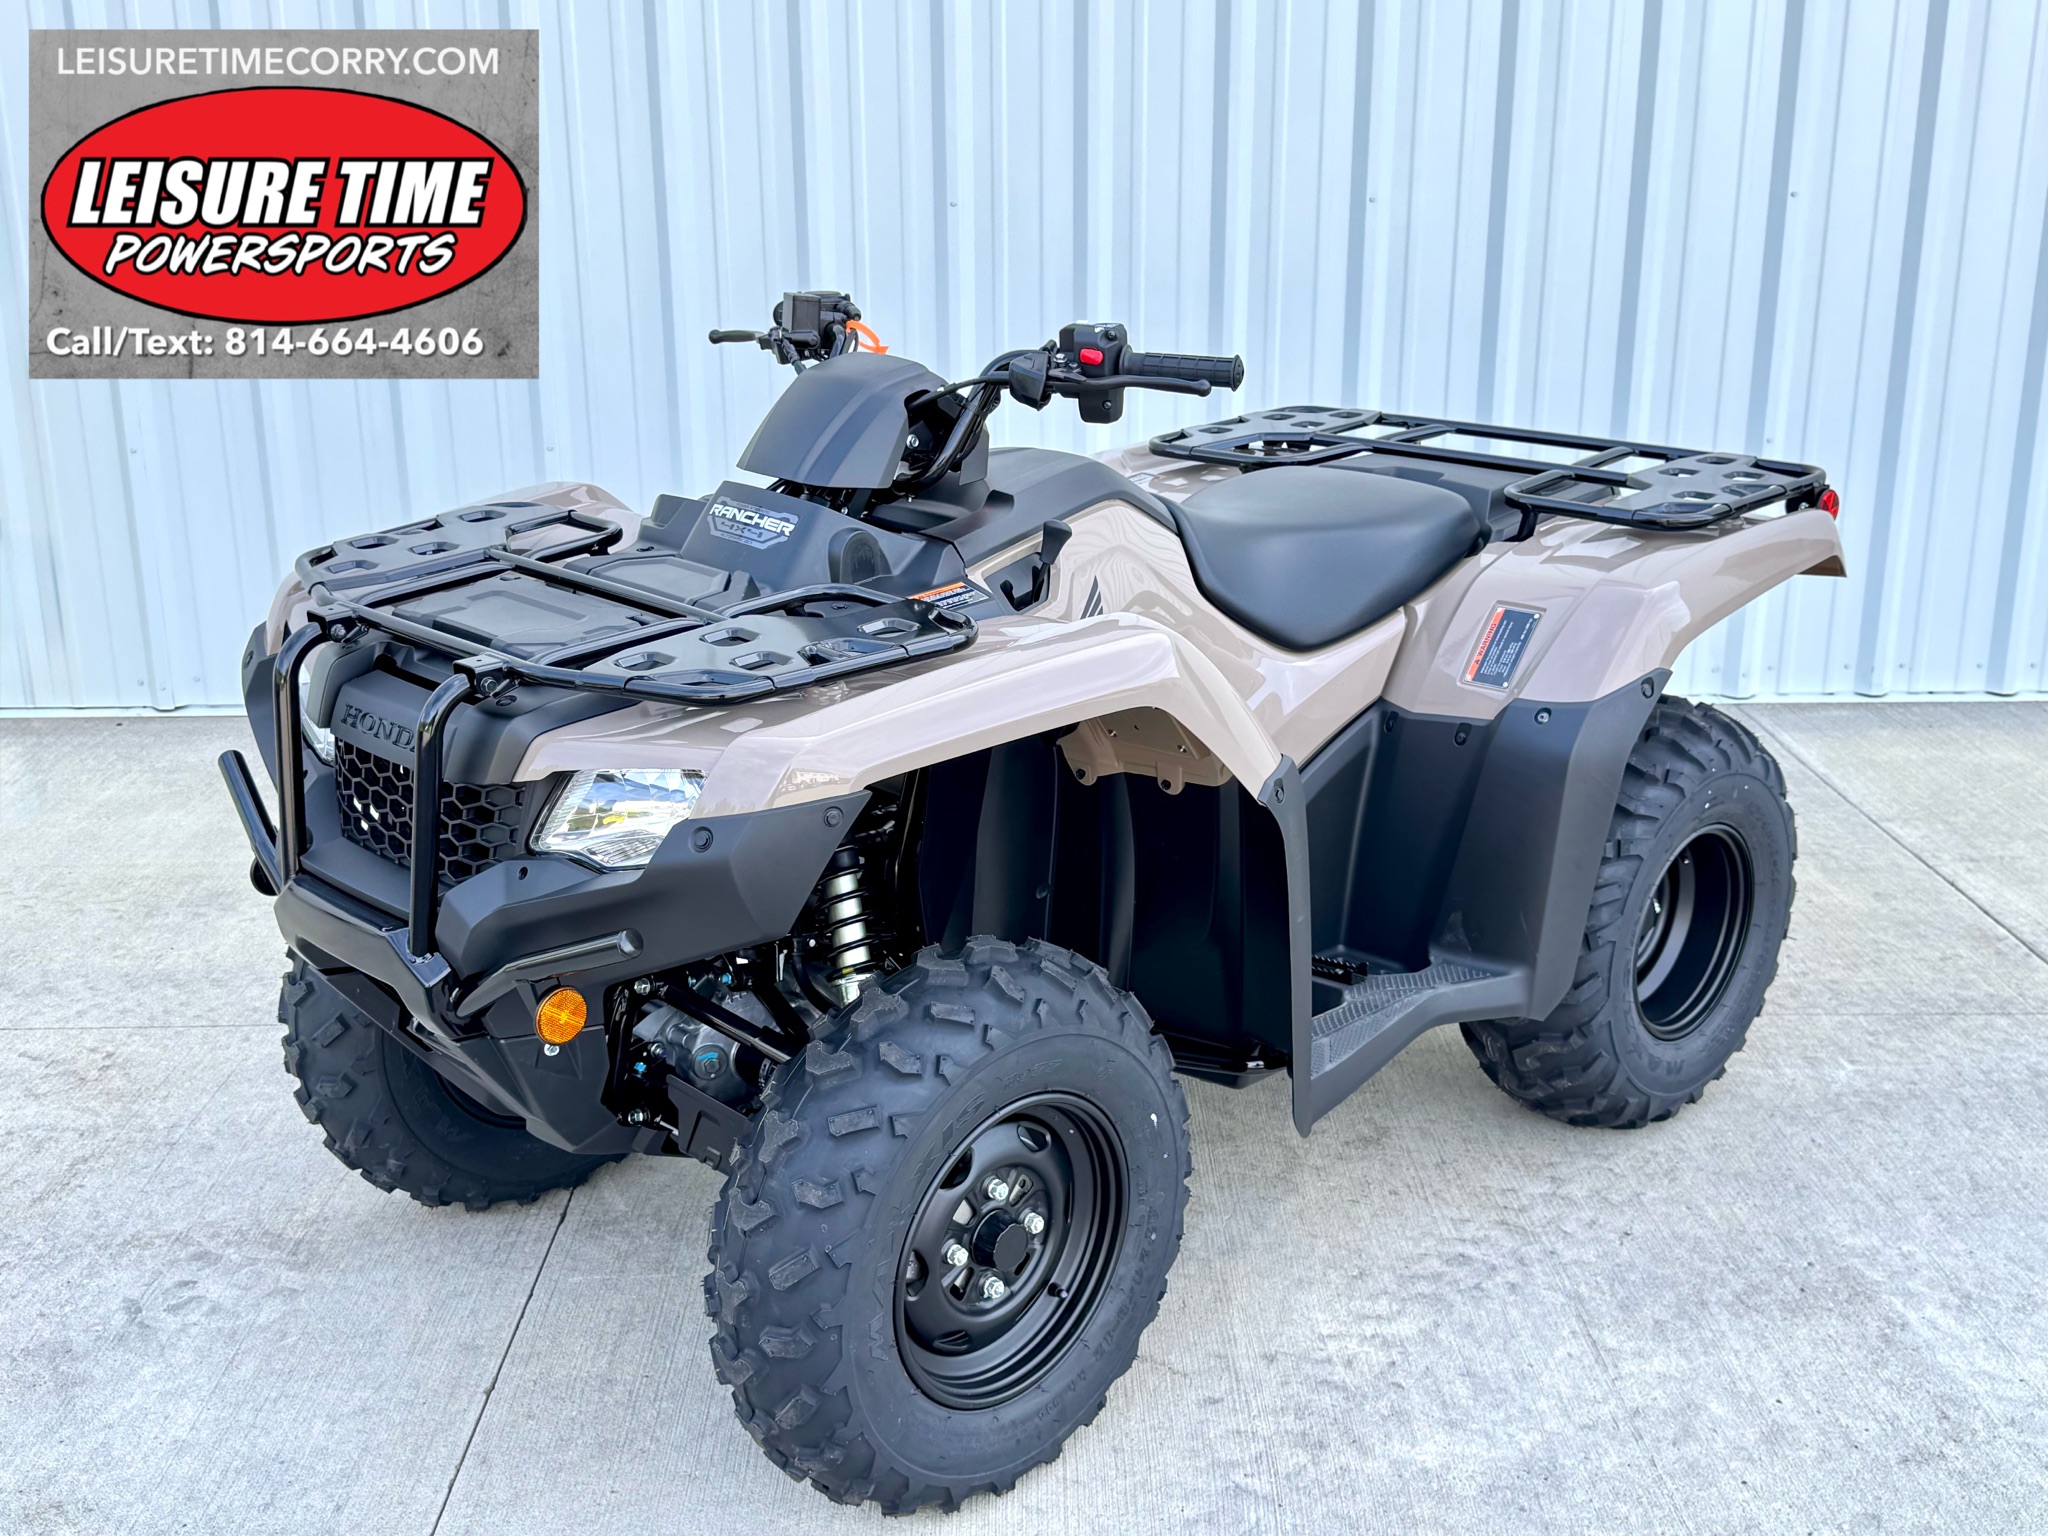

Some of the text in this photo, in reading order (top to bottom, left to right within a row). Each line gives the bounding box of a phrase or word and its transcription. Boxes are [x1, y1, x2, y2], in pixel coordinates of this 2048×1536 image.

[709, 503, 796, 536] RANCHER
[1477, 622, 1497, 657] WARNING
[340, 703, 416, 753] HOND
